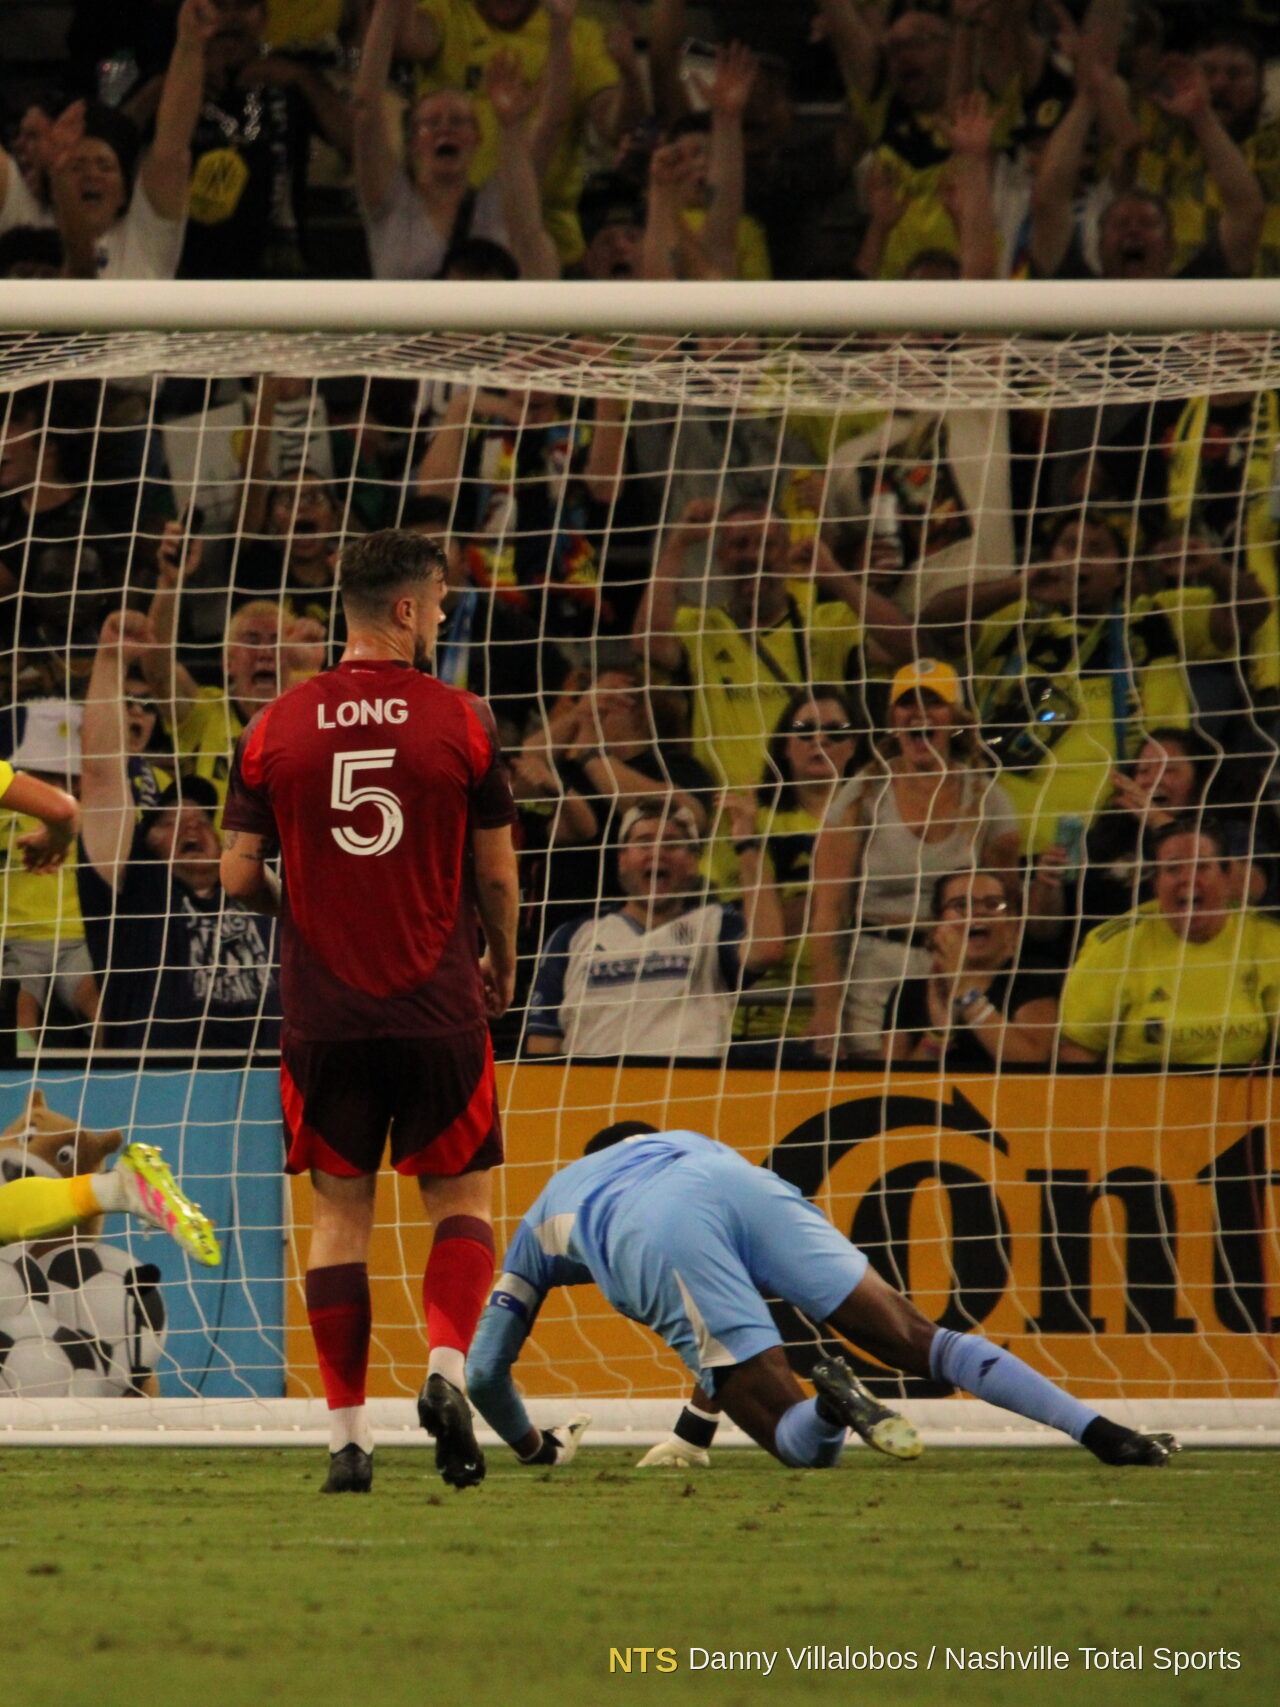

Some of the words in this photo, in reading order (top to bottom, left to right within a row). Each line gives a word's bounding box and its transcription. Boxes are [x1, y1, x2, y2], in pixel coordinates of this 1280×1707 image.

[317, 698, 409, 730] LONG
[330, 748, 404, 857] 5
[496, 1294, 511, 1308] C
